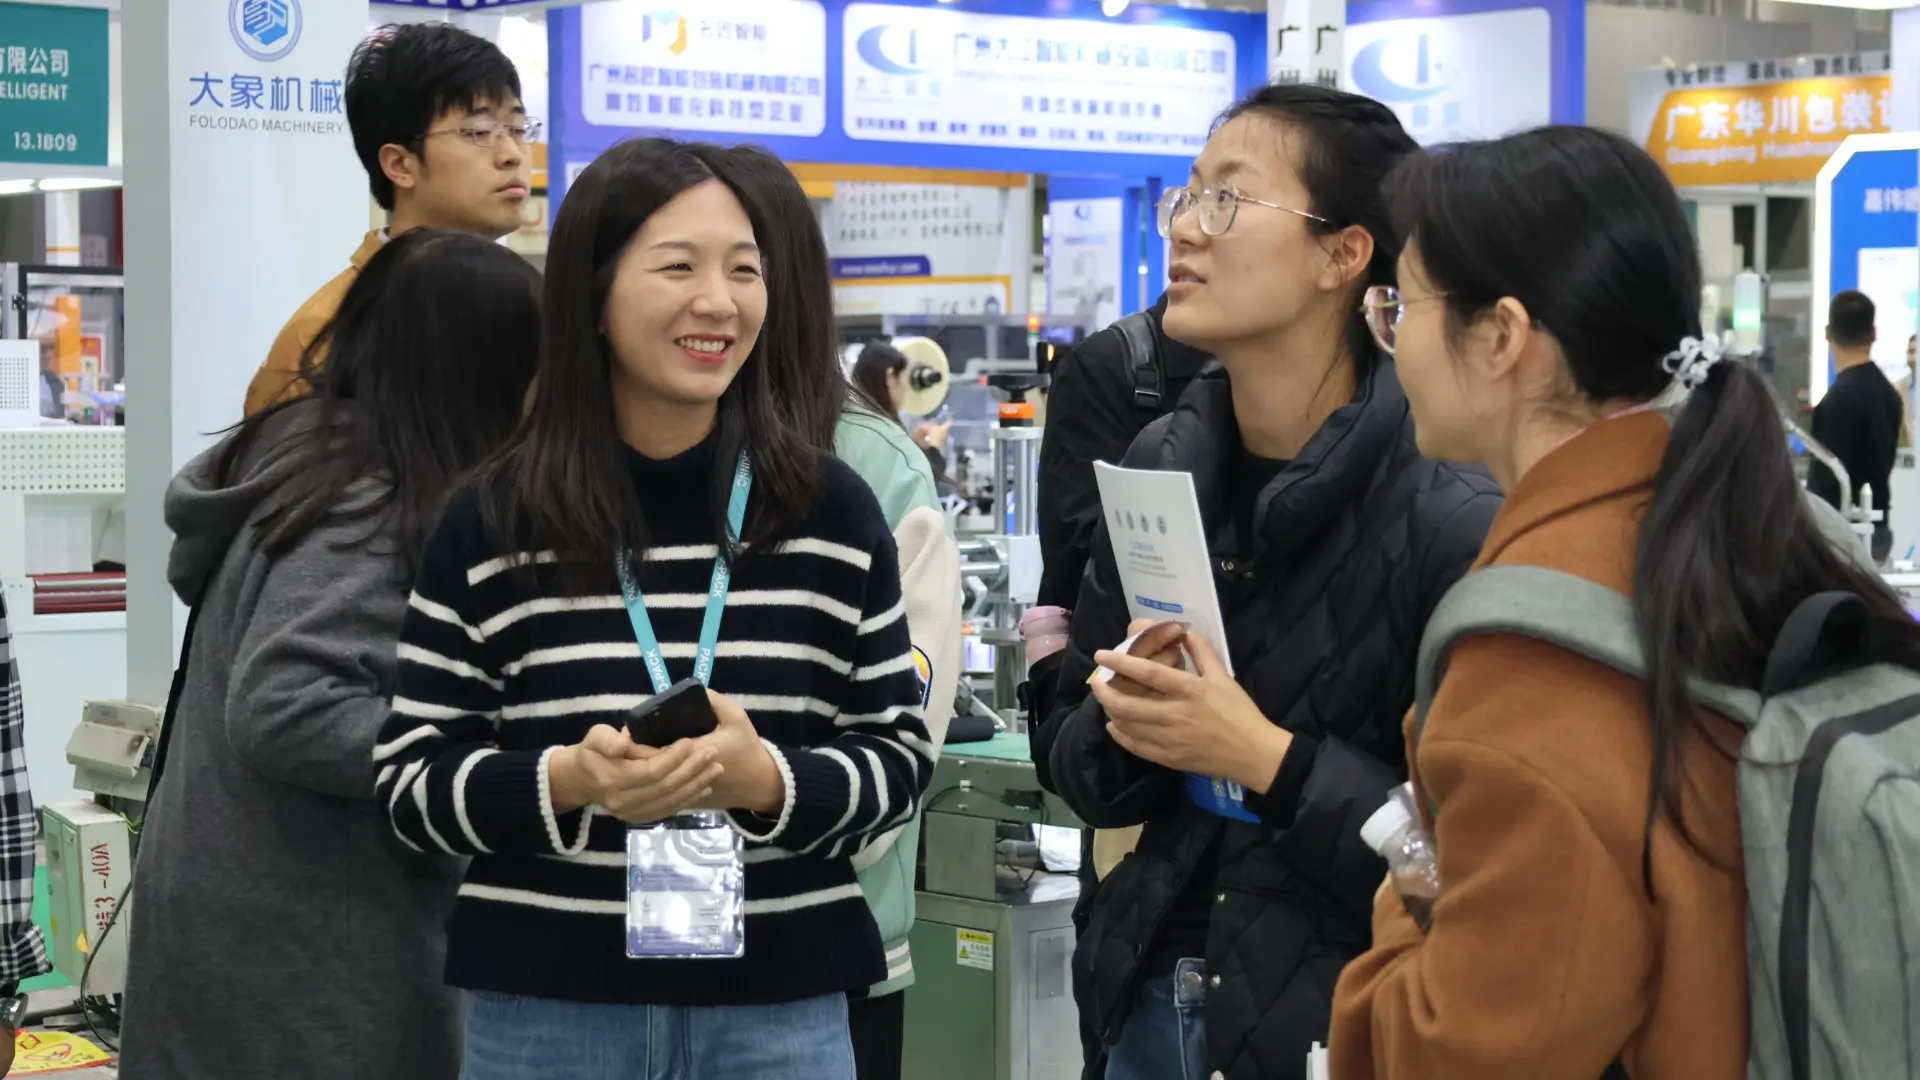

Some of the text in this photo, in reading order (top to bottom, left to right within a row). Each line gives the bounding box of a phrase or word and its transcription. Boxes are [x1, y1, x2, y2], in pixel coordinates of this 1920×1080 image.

[189, 71, 344, 115] 大象机械
[189, 114, 344, 135] FOLODAO MACHINERY
[13, 130, 78, 152] 13.1B09
[696, 646, 712, 685] PACK
